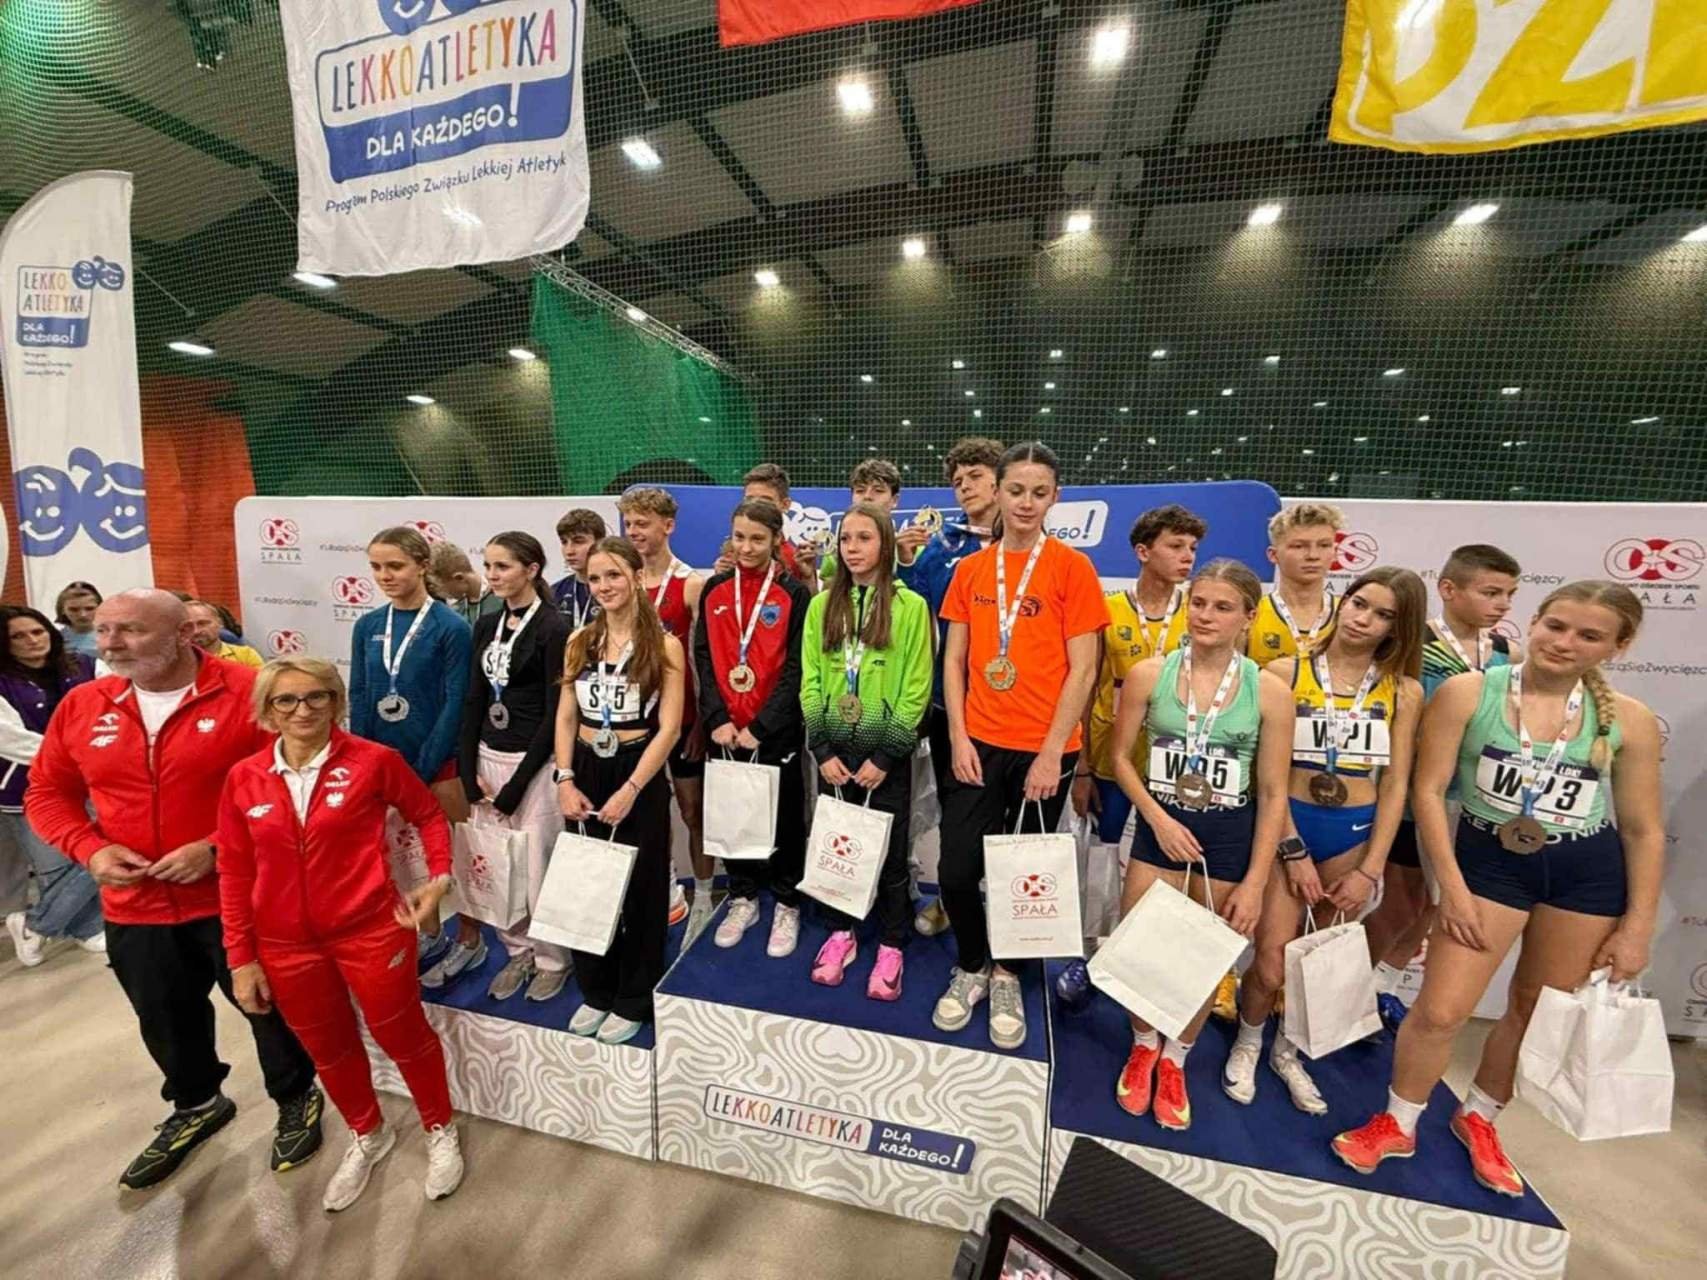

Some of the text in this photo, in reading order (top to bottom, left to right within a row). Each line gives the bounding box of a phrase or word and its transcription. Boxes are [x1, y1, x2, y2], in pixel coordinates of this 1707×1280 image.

[331, 8, 556, 113] LEKKOATLETYKA
[366, 131, 405, 160] DLA
[370, 182, 420, 204] Polskiego
[424, 171, 469, 193] Związku
[472, 158, 513, 181] Lekkiej
[24, 271, 67, 290] LEKKO
[589, 683, 625, 710] S5
[1491, 763, 1583, 811] W3
[1011, 903, 1058, 917] SPAŁA
[712, 1091, 864, 1146] LEKKOATLETYKA
[881, 1127, 913, 1143] DLA
[879, 1141, 966, 1169] KAŻDEGO!
